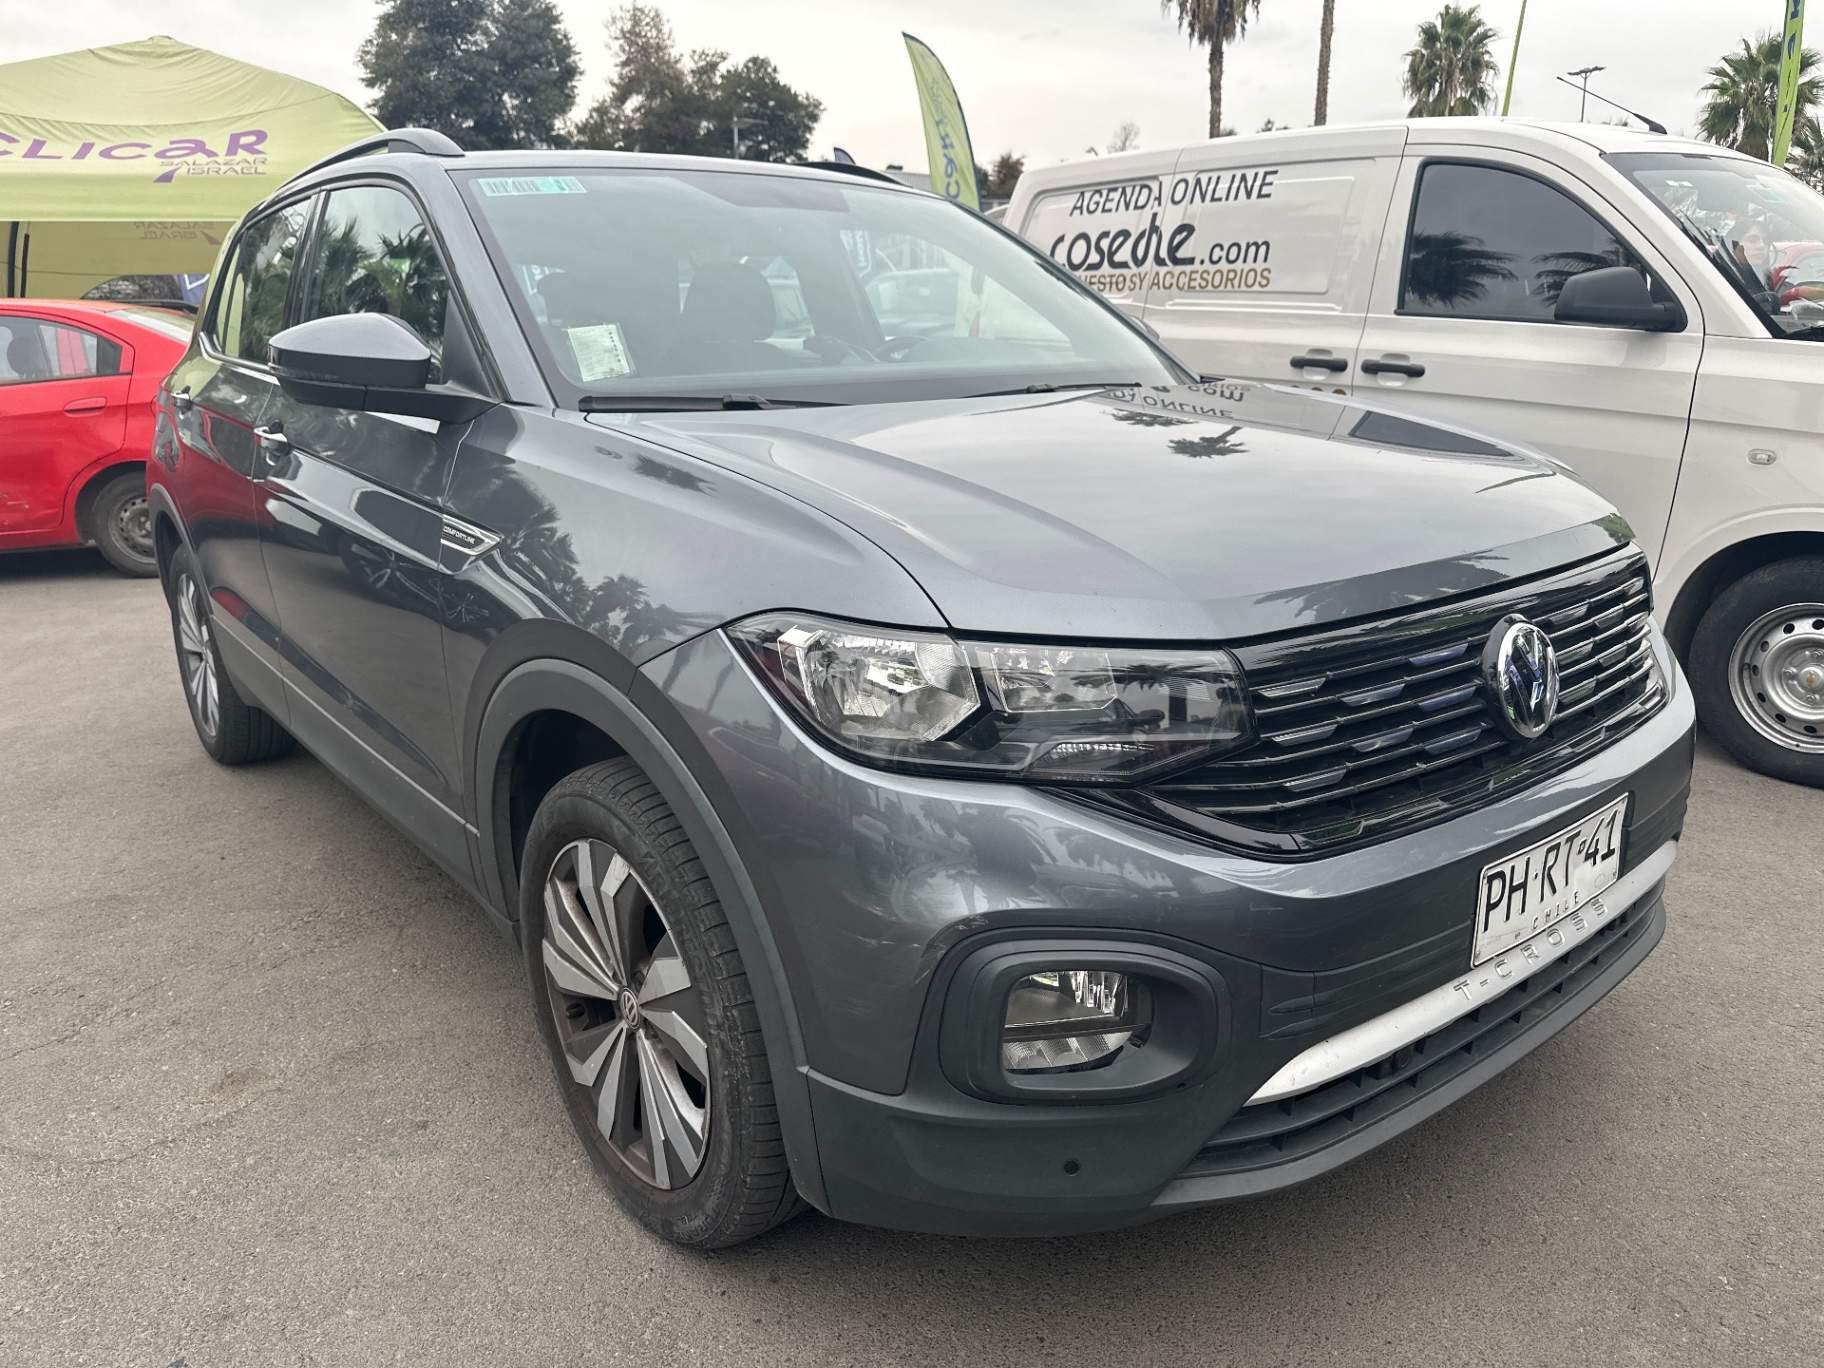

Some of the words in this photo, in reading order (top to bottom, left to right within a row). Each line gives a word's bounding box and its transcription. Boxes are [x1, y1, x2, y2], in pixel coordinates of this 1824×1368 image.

[159, 157, 268, 167] SALAZAR
[186, 166, 268, 176] ISRAEL
[1069, 180, 1163, 216] AGENDA
[1171, 170, 1280, 206] ONLINE
[1150, 268, 1272, 292] ACCESORIOS
[1531, 890, 1580, 931] CHILE
[1453, 898, 1608, 1001] T-CROSS
